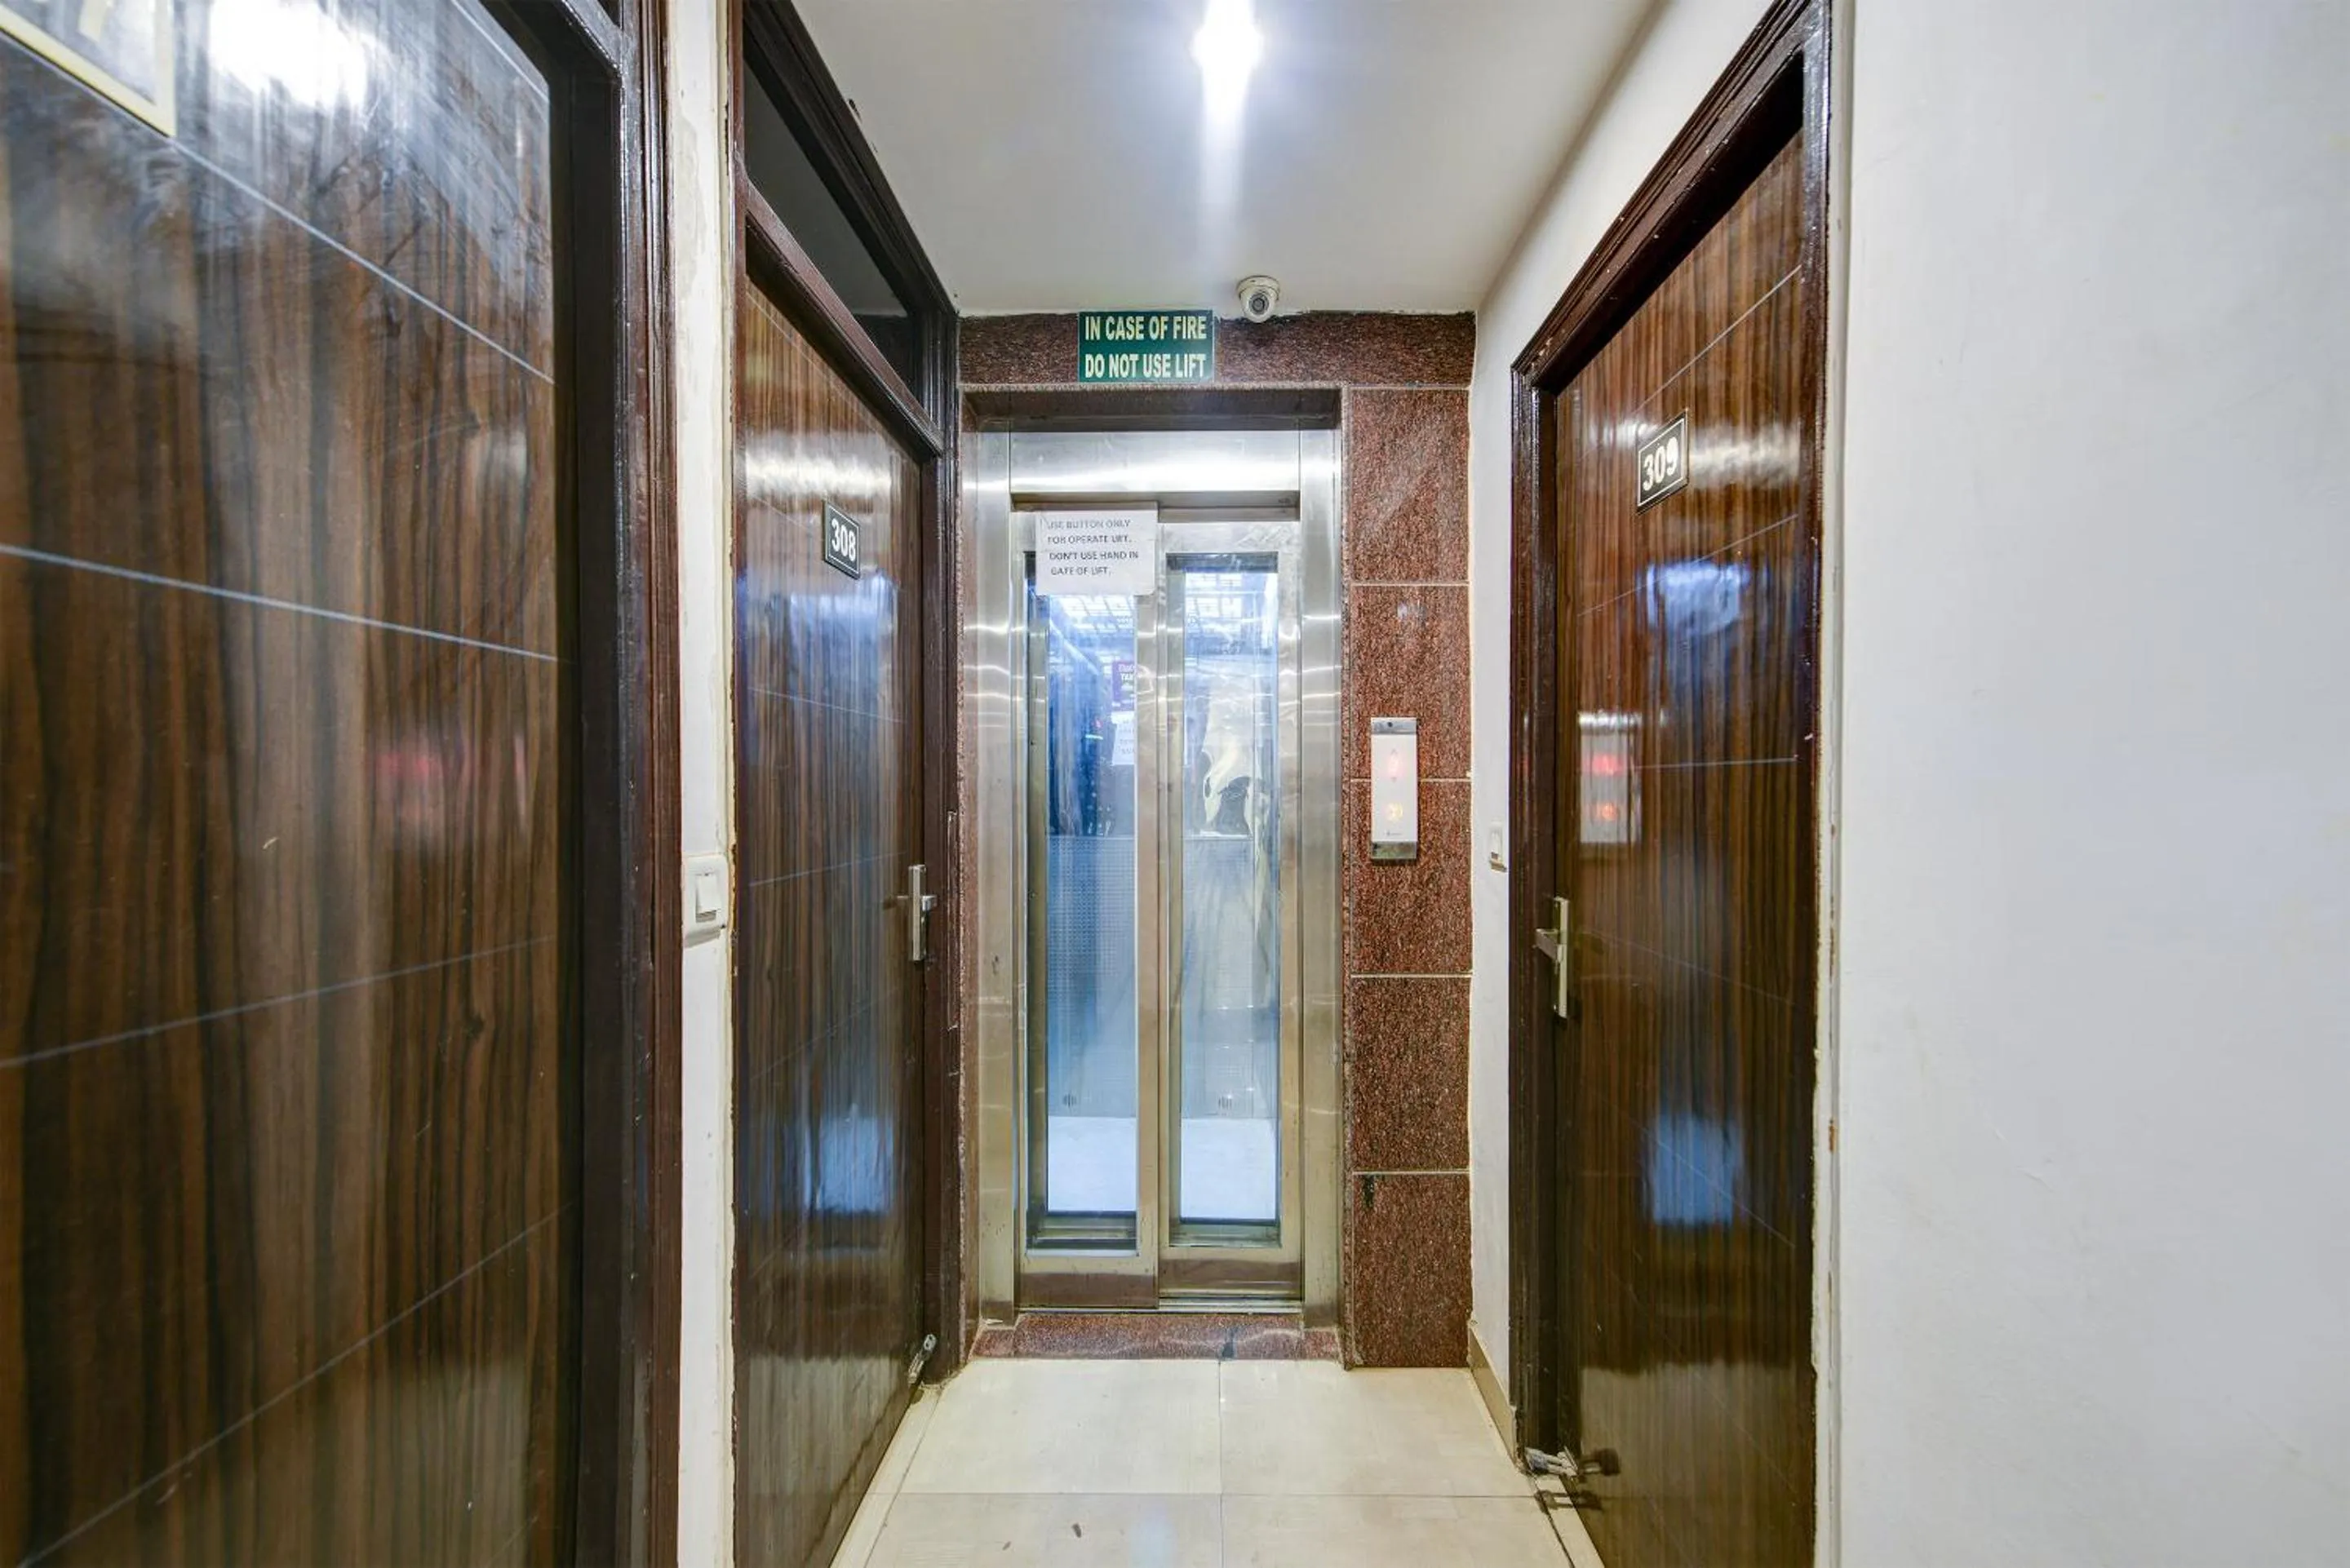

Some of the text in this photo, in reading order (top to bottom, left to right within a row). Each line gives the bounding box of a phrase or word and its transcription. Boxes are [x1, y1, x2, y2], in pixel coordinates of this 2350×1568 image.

[1085, 316, 1207, 340] IN CASE OF FIRE
[1085, 353, 1206, 379] DO NOT USE LIFT
[1643, 436, 1678, 491] 309
[1066, 520, 1103, 529] BUTTON
[1106, 519, 1131, 529] ONLY
[831, 518, 856, 562] 308
[1048, 535, 1066, 544] FOR
[1068, 535, 1108, 544] OPERATE
[1049, 551, 1139, 560] DON'T USE HAND IN
[1051, 567, 1074, 575] GATE
[1077, 567, 1088, 575] OF
